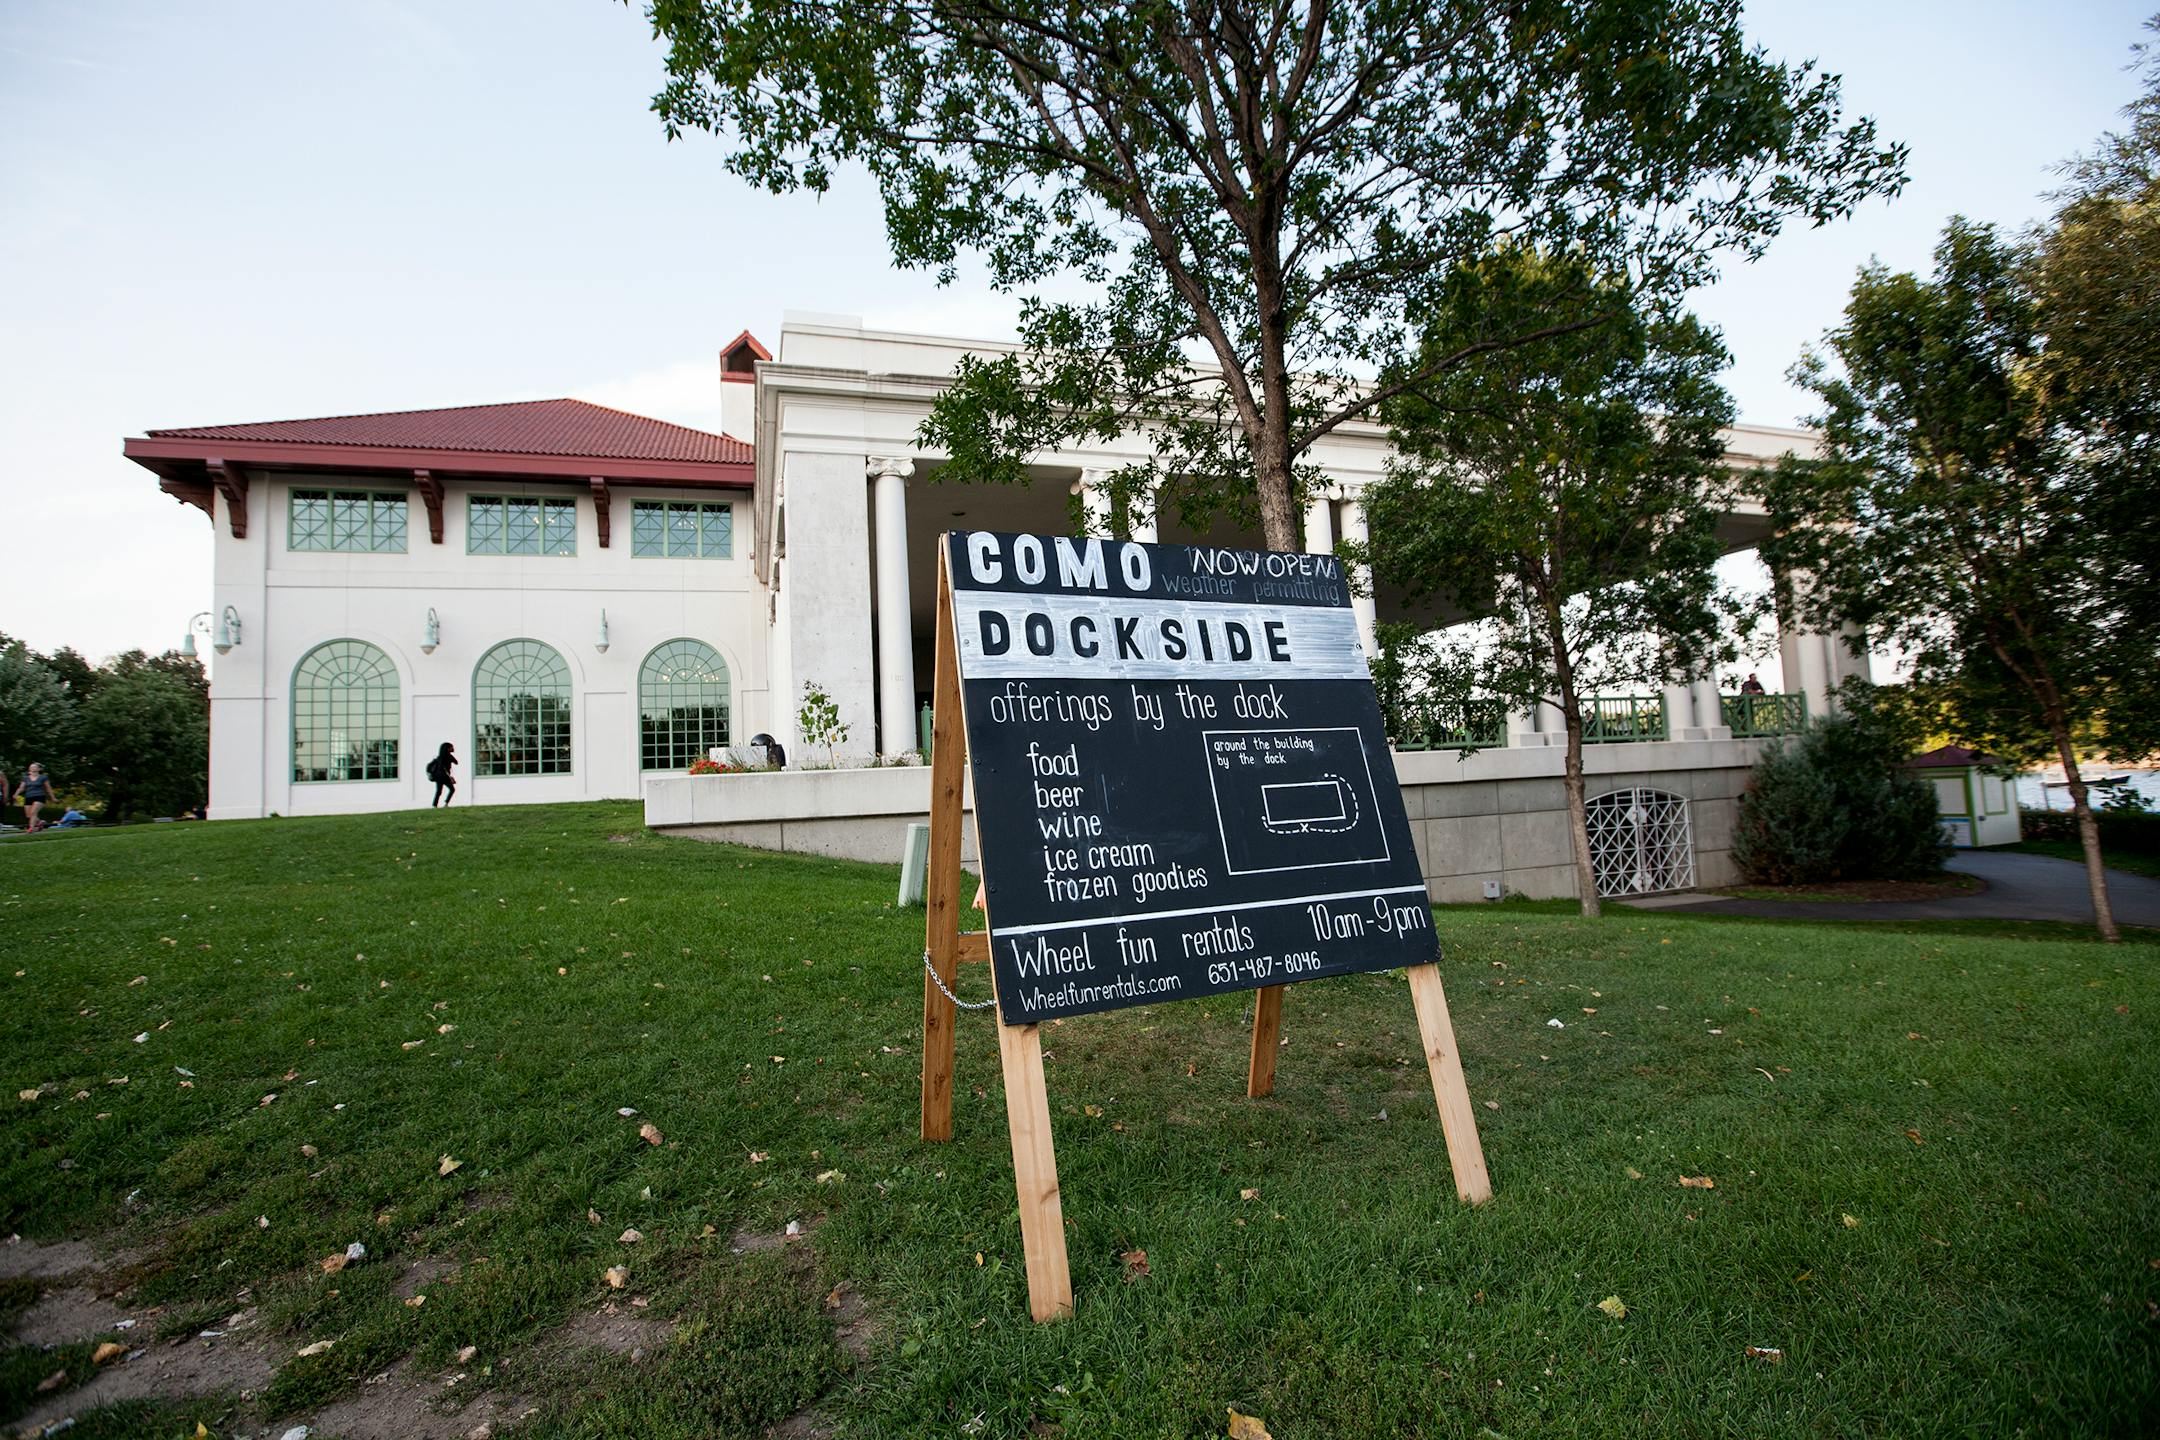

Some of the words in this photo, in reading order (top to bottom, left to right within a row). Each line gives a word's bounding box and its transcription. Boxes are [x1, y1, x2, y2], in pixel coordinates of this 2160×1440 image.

[967, 531, 1153, 592] COMO
[1192, 549, 1260, 576] NOW
[1266, 553, 1334, 580] OPEN
[1162, 573, 1236, 597] weather
[1253, 576, 1340, 605] permitting
[978, 610, 1291, 662] DOCKSIDE
[990, 682, 1113, 731] offerings
[1131, 684, 1165, 731] by
[1175, 683, 1217, 720] the
[1234, 683, 1289, 720] dock
[1026, 742, 1079, 777] food
[1213, 738, 1247, 752] around
[1253, 737, 1271, 751] the
[1274, 735, 1315, 752] building
[1216, 755, 1231, 770] by
[1239, 754, 1256, 766] the
[1264, 752, 1287, 765] dock
[1034, 780, 1084, 809] beer
[1039, 811, 1102, 840] wine
[1043, 845, 1079, 873] ice
[1088, 842, 1155, 869] cream
[1044, 873, 1118, 903] frozen
[1132, 865, 1209, 904] goodies
[1011, 932, 1096, 979] Wheel
[1116, 927, 1157, 966] fun
[1182, 915, 1256, 959] rentals
[1207, 951, 1322, 985] 651-487-8046
[1018, 972, 1182, 1013] Wheelfunrentals.com
